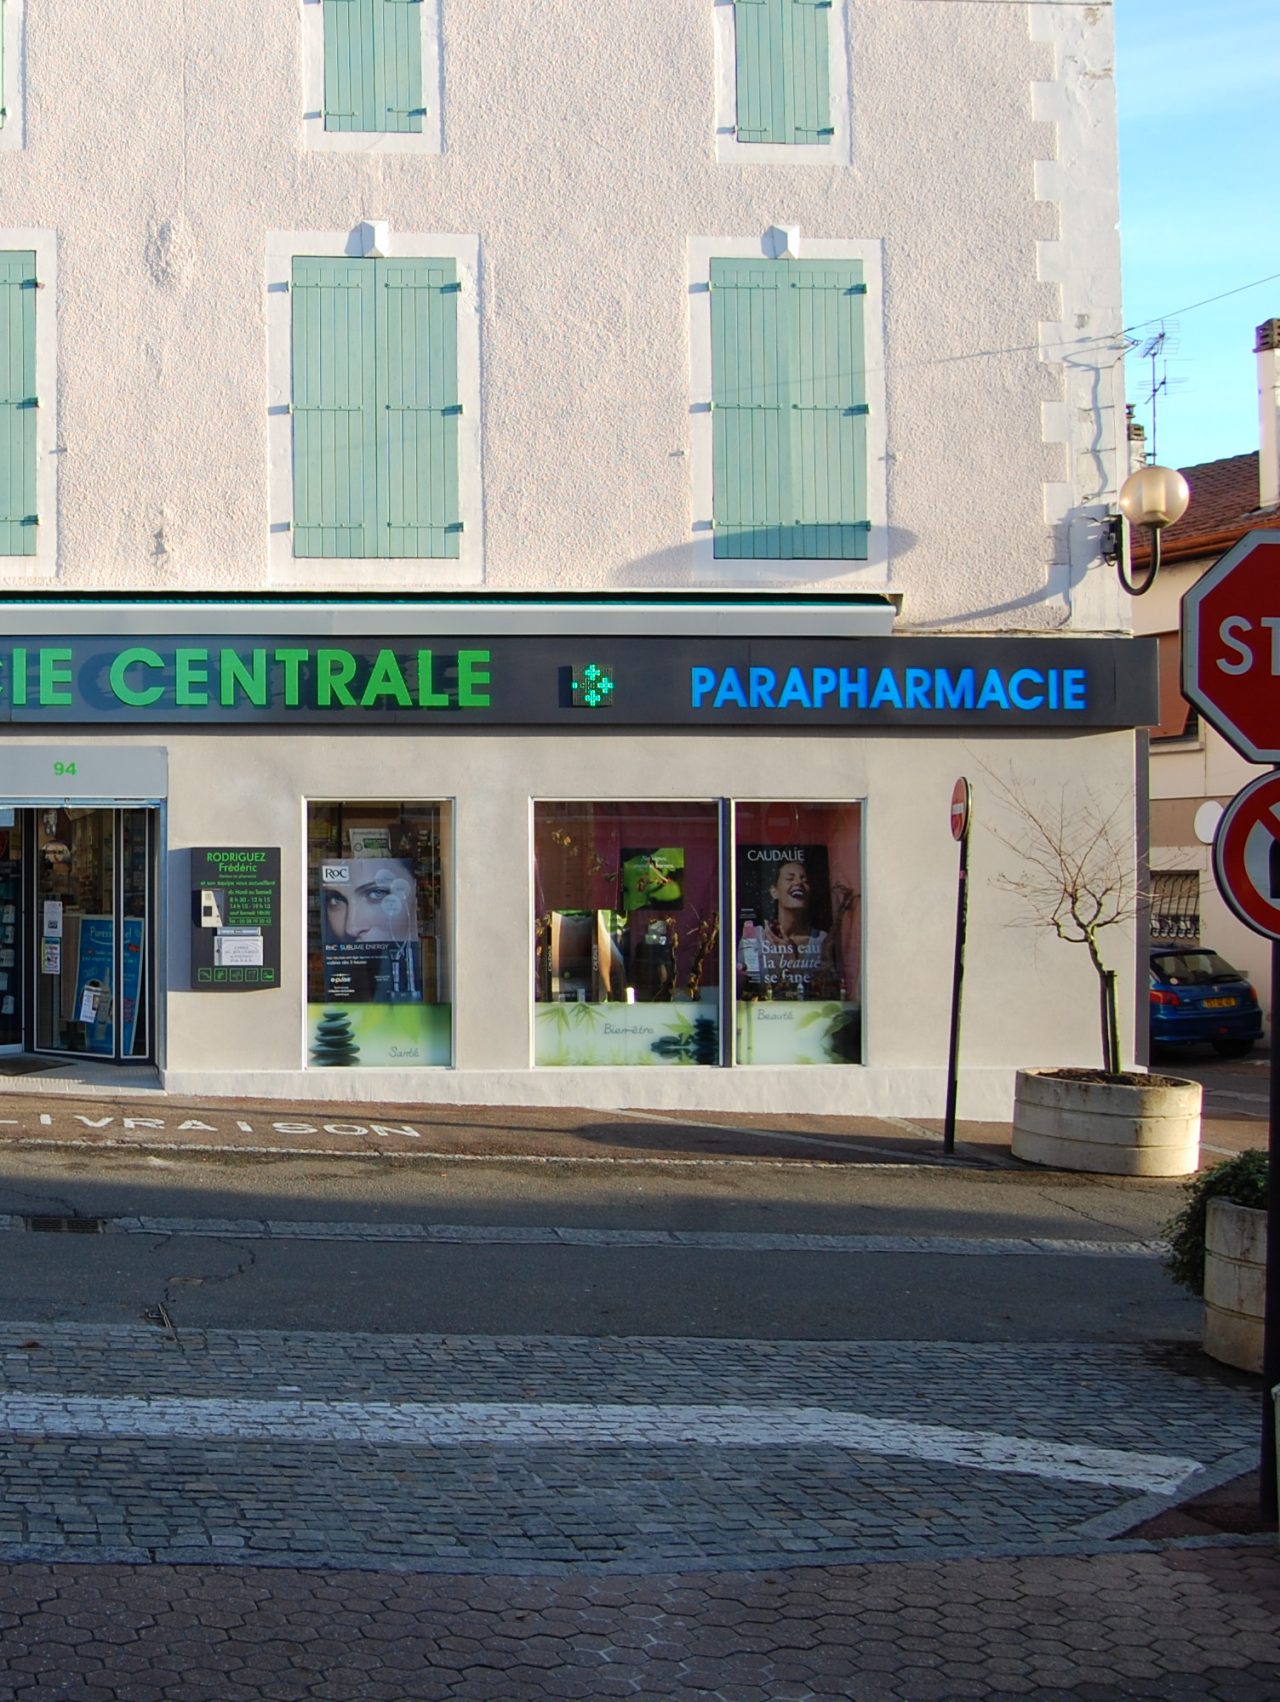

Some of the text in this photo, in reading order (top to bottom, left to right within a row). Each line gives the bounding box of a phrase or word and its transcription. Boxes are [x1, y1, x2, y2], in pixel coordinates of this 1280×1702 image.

[111, 648, 491, 707] CENTRALE
[691, 667, 1086, 710] PARAPHARMACIE
[53, 761, 77, 776] 94
[207, 852, 266, 862] RODRIGUEZ
[219, 862, 257, 872] Frédéric
[761, 941, 822, 954] Sans eau
[763, 954, 821, 969] la beauté
[764, 973, 778, 983] se
